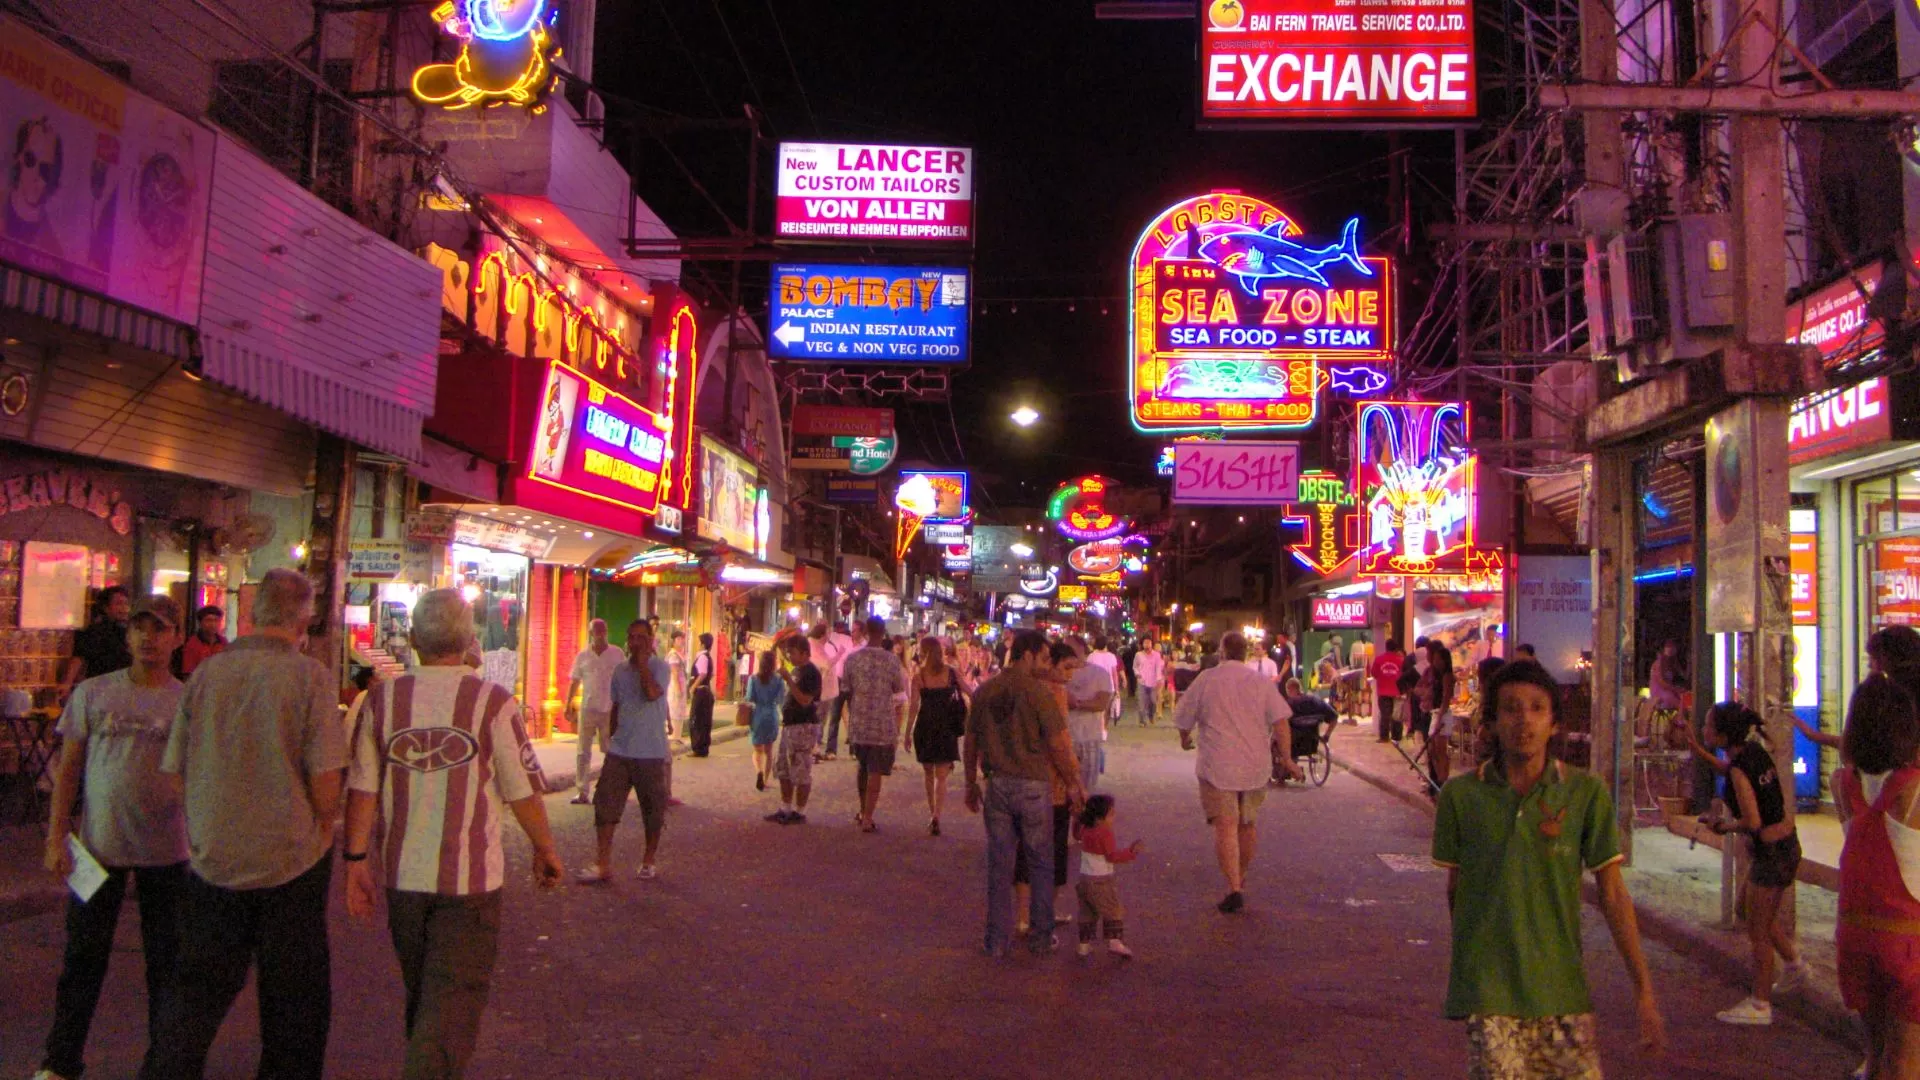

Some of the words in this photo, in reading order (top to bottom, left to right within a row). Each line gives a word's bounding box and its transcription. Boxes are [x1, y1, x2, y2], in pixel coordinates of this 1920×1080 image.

[1250, 15, 1270, 31] BAI
[1275, 15, 1306, 31] FERN
[1312, 15, 1357, 31] TRAVEL
[1361, 15, 1412, 31] SERVICE
[1206, 53, 1468, 102] EXCHANGE
[786, 158, 817, 170] New
[837, 148, 965, 174] LANCER
[795, 175, 875, 191] CUSTOM
[881, 177, 961, 194] TAILORS
[804, 199, 858, 218] VON
[865, 200, 945, 221] ALLEN
[781, 221, 848, 235] REISEUNTER
[850, 223, 899, 236] NEHMEN
[900, 224, 967, 237] EMPFOHLEN
[780, 274, 940, 314] BOMBAY
[780, 308, 834, 318] PALACE
[1161, 289, 1238, 325] SEA
[1263, 289, 1379, 325] ZONE
[810, 323, 860, 335] INDIAN
[865, 324, 956, 337] RESTAURANT
[1170, 329, 1210, 344] SEA
[1219, 329, 1277, 346] FOOD
[1304, 329, 1371, 346] STEAK
[806, 342, 834, 353] VEG
[838, 343, 848, 353] &
[853, 343, 884, 354] NON
[890, 344, 917, 355] VEG
[921, 344, 960, 356] FOOD
[1143, 403, 1202, 416] STEAKS
[1217, 404, 1251, 416] THAI
[1266, 404, 1309, 416] FOOD
[1178, 451, 1294, 493] SUSHI
[1318, 503, 1338, 568] WELCOME
[1316, 603, 1365, 616] AMARIO
